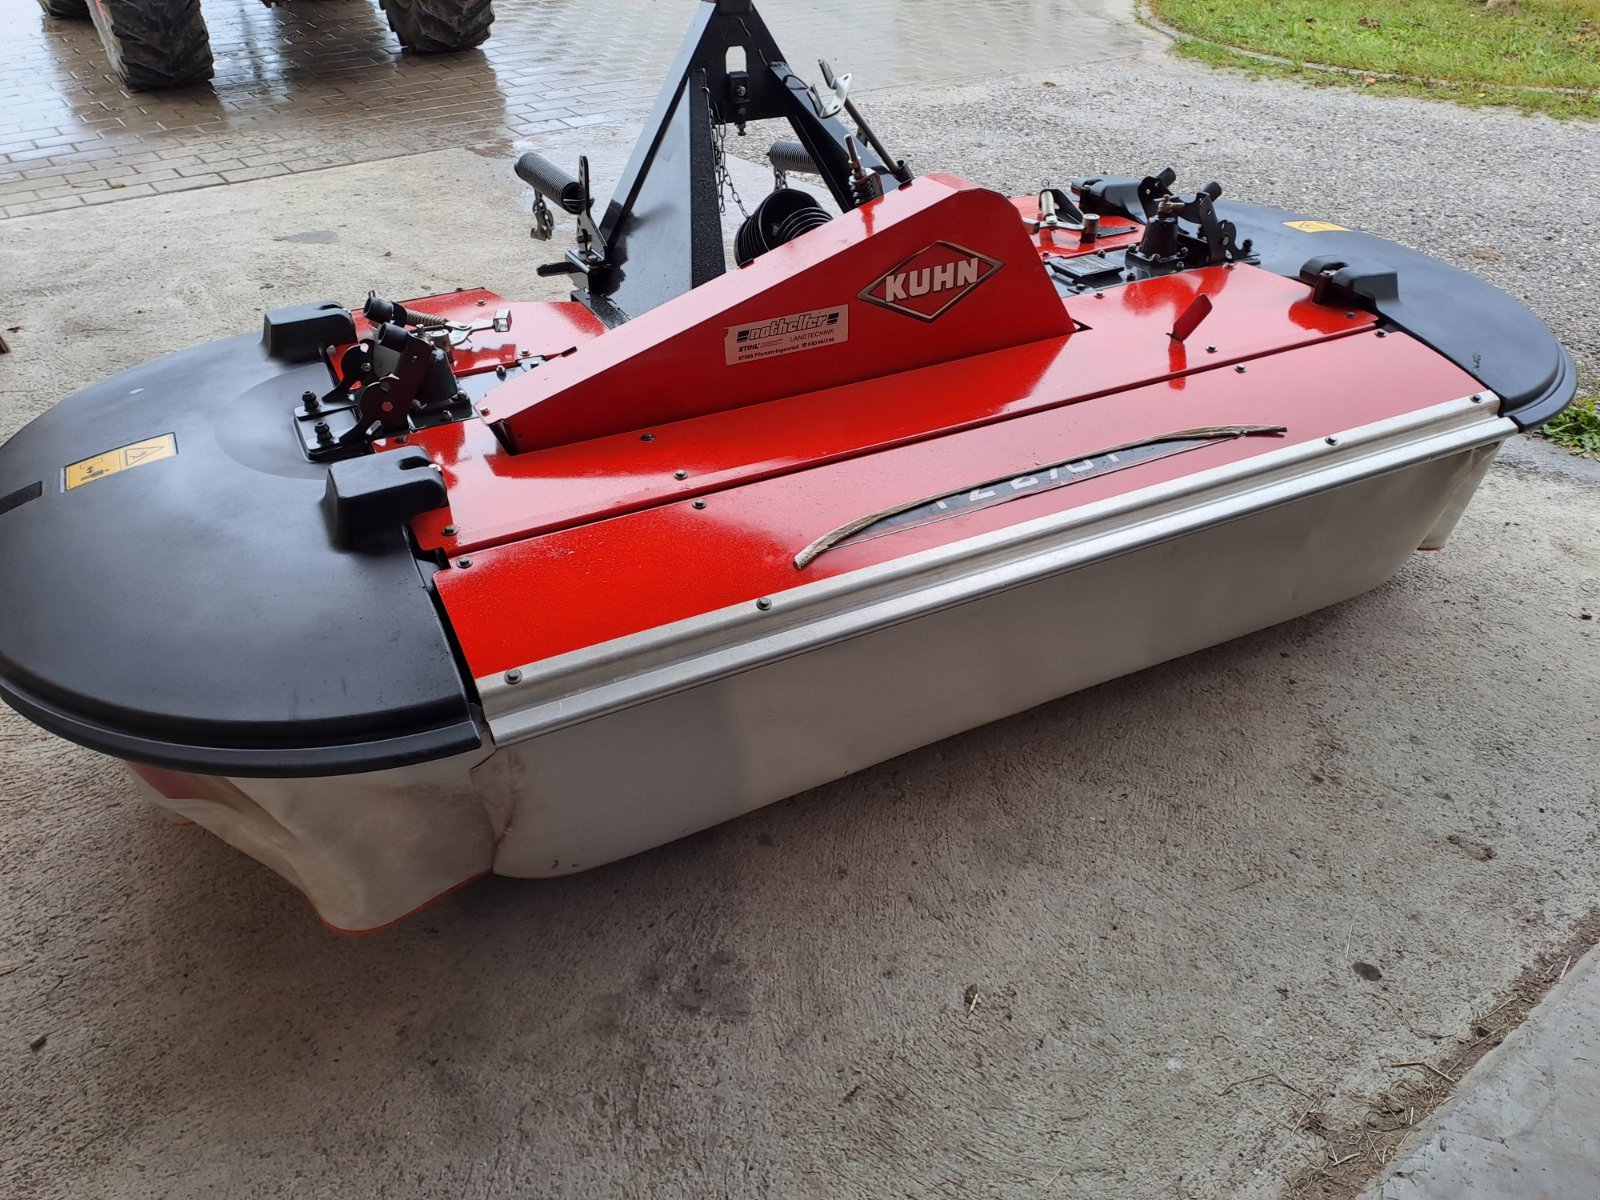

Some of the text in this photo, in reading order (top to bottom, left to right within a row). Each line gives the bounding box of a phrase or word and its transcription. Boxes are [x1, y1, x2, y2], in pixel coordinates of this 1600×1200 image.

[885, 257, 979, 303] KUHN
[749, 313, 828, 341] nothelfer
[790, 328, 835, 342] LANDTECHNIK
[738, 343, 760, 353] STIHL
